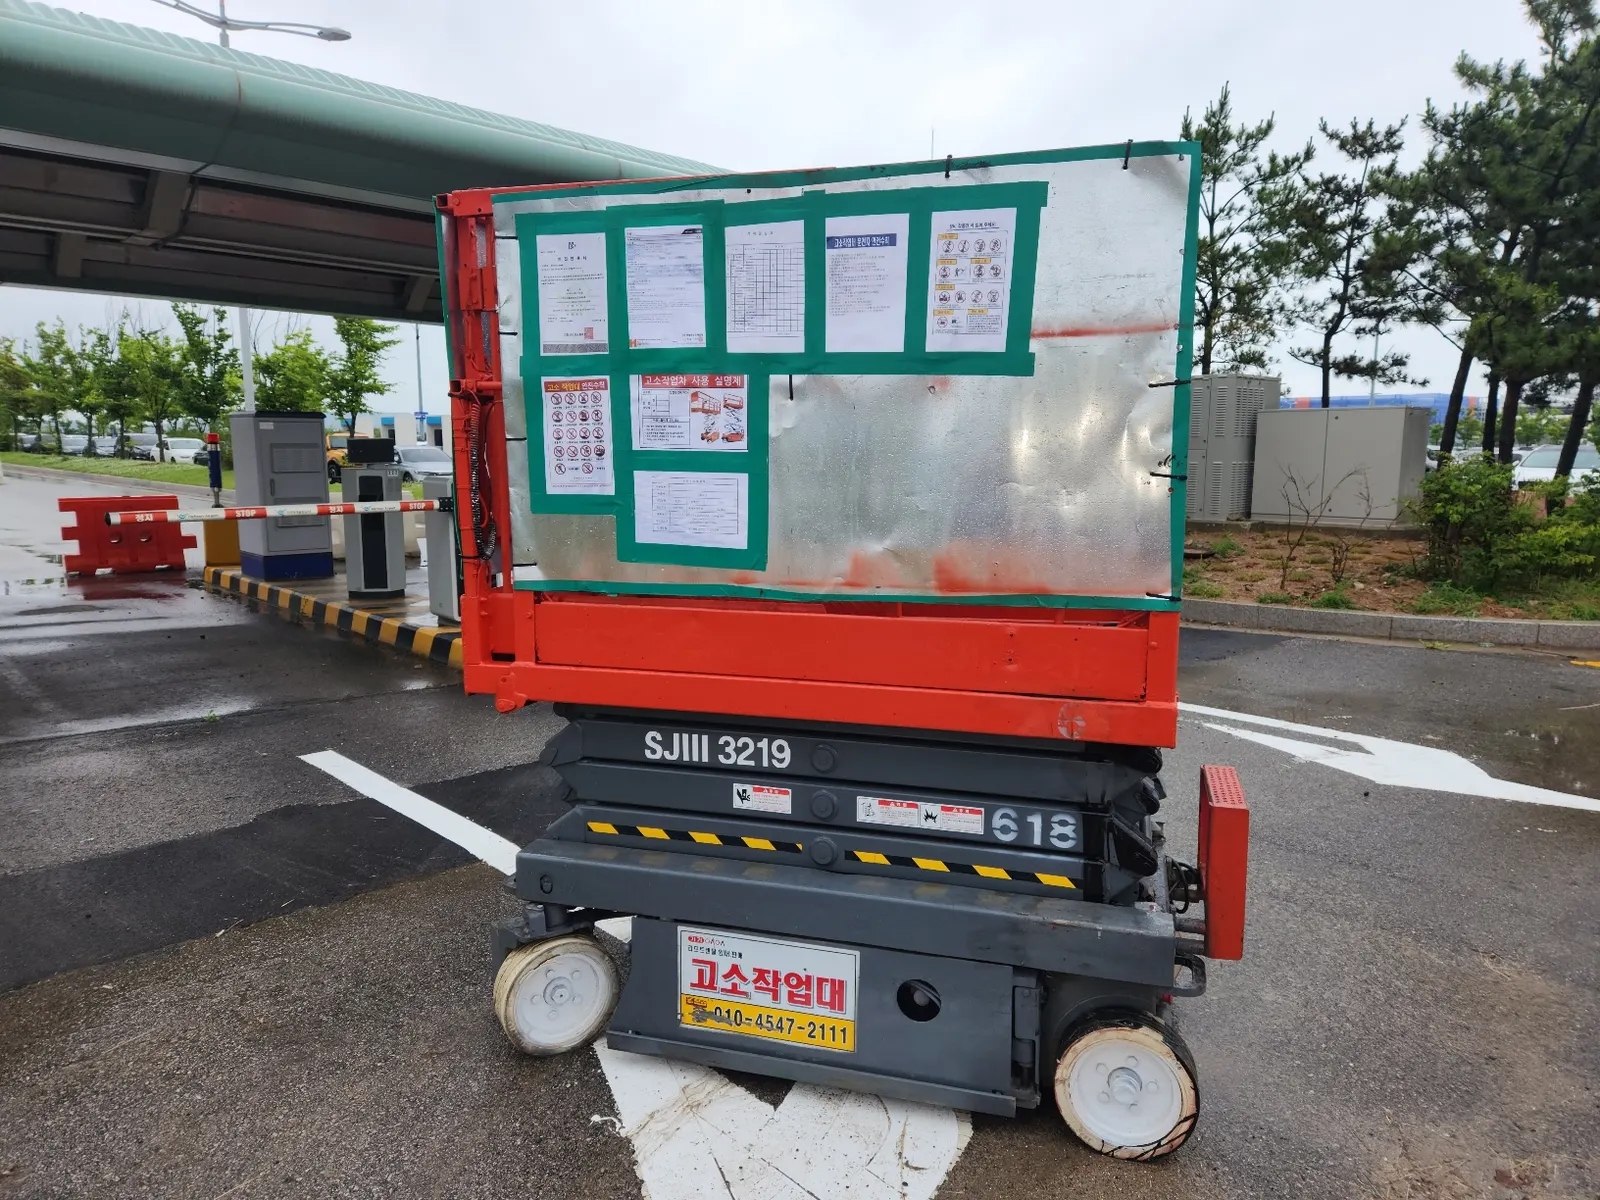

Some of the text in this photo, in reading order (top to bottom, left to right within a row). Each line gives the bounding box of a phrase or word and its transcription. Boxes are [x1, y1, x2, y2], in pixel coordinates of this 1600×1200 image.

[857, 237, 871, 247] 운전자
[561, 382, 580, 391] 작업대
[581, 380, 605, 390] 안전수칙
[644, 375, 741, 386] 고소작업차 사용 실명제
[409, 502, 426, 510] STOP
[135, 514, 154, 522] 정지
[235, 509, 257, 518] STOP
[644, 730, 791, 769] SJIII 3219
[991, 806, 1078, 849] 618
[690, 958, 846, 1014] 고소작업대
[714, 1006, 848, 1044] 010-4547-2111
